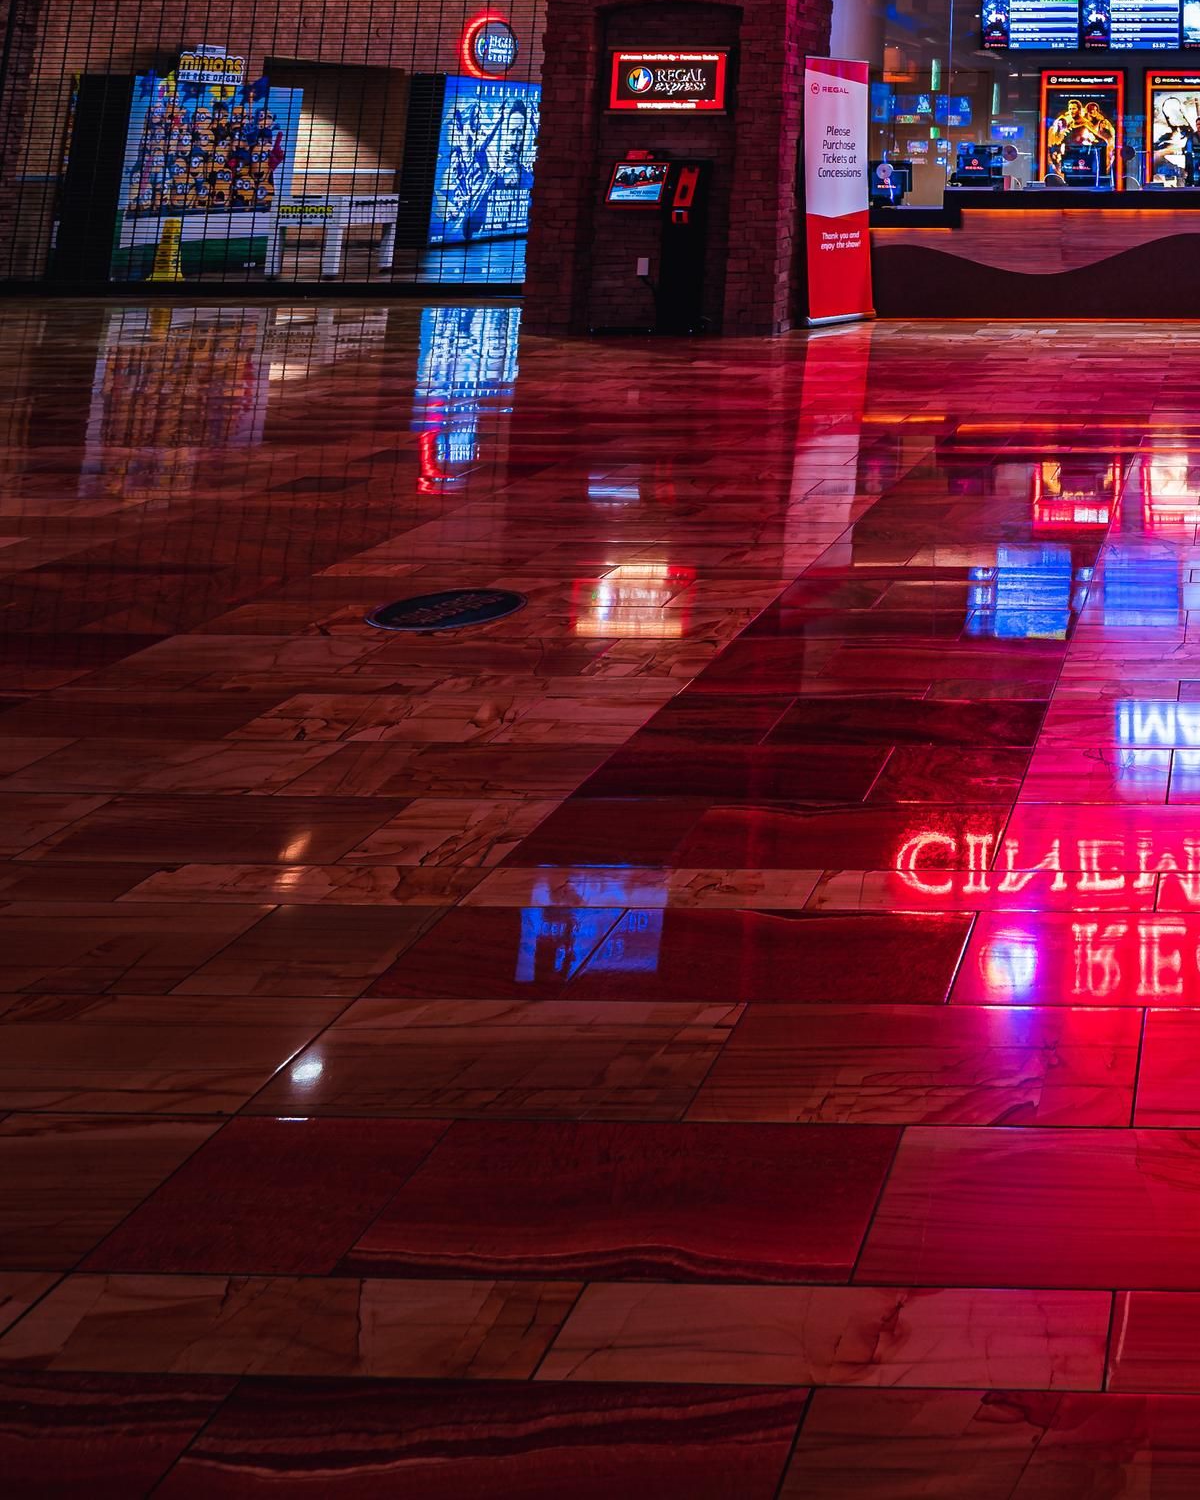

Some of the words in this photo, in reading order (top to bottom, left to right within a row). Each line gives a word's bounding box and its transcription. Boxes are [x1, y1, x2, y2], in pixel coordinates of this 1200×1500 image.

[654, 68, 706, 82] REGAL
[822, 86, 849, 94] REGAL
[826, 125, 851, 137] Please
[822, 139, 856, 151] Purchase
[822, 153, 848, 164] Tickets
[848, 155, 857, 164] at
[817, 167, 862, 178] Concessions
[822, 231, 839, 240] Thank
